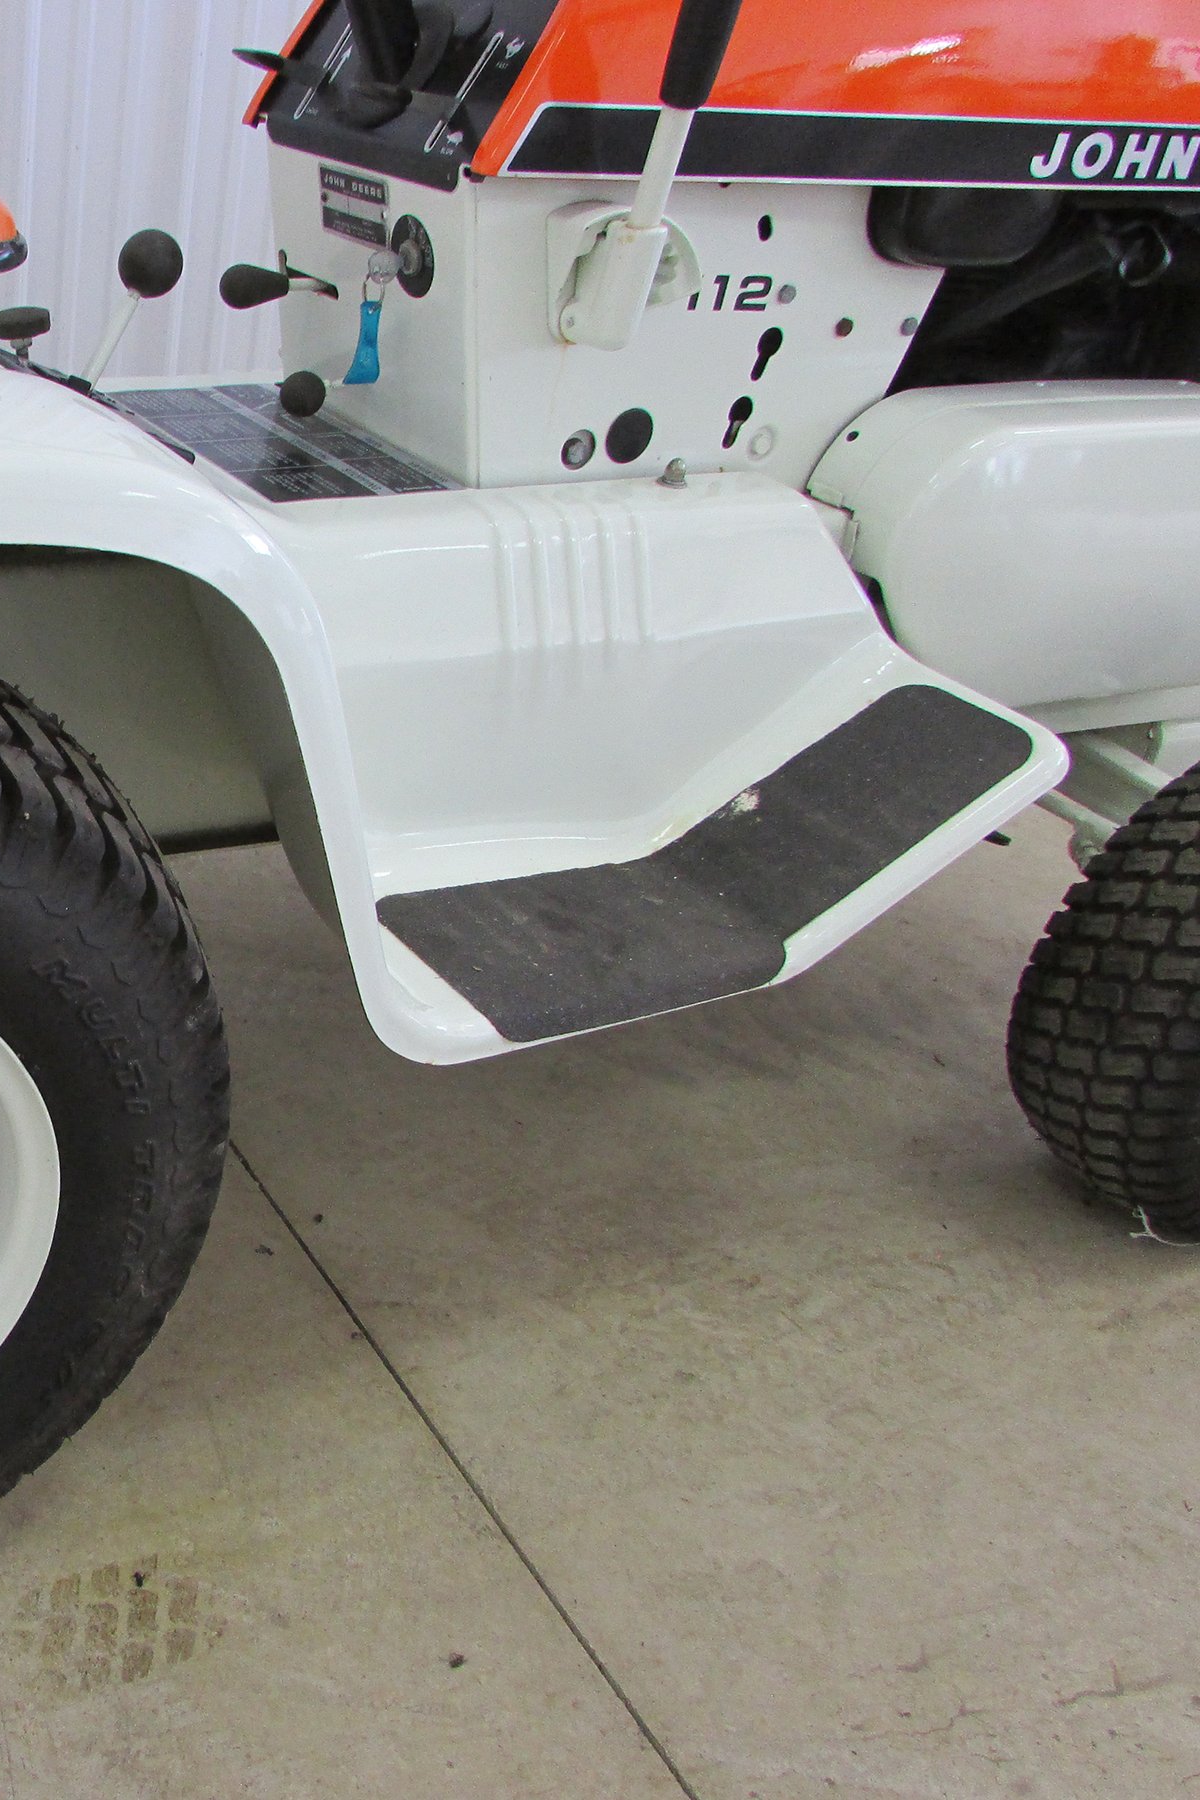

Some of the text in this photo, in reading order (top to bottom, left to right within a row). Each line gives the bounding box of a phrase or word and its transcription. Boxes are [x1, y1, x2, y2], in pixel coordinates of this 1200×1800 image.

[1029, 131, 1200, 180] JOHN
[323, 173, 383, 199] JOHN DEERE
